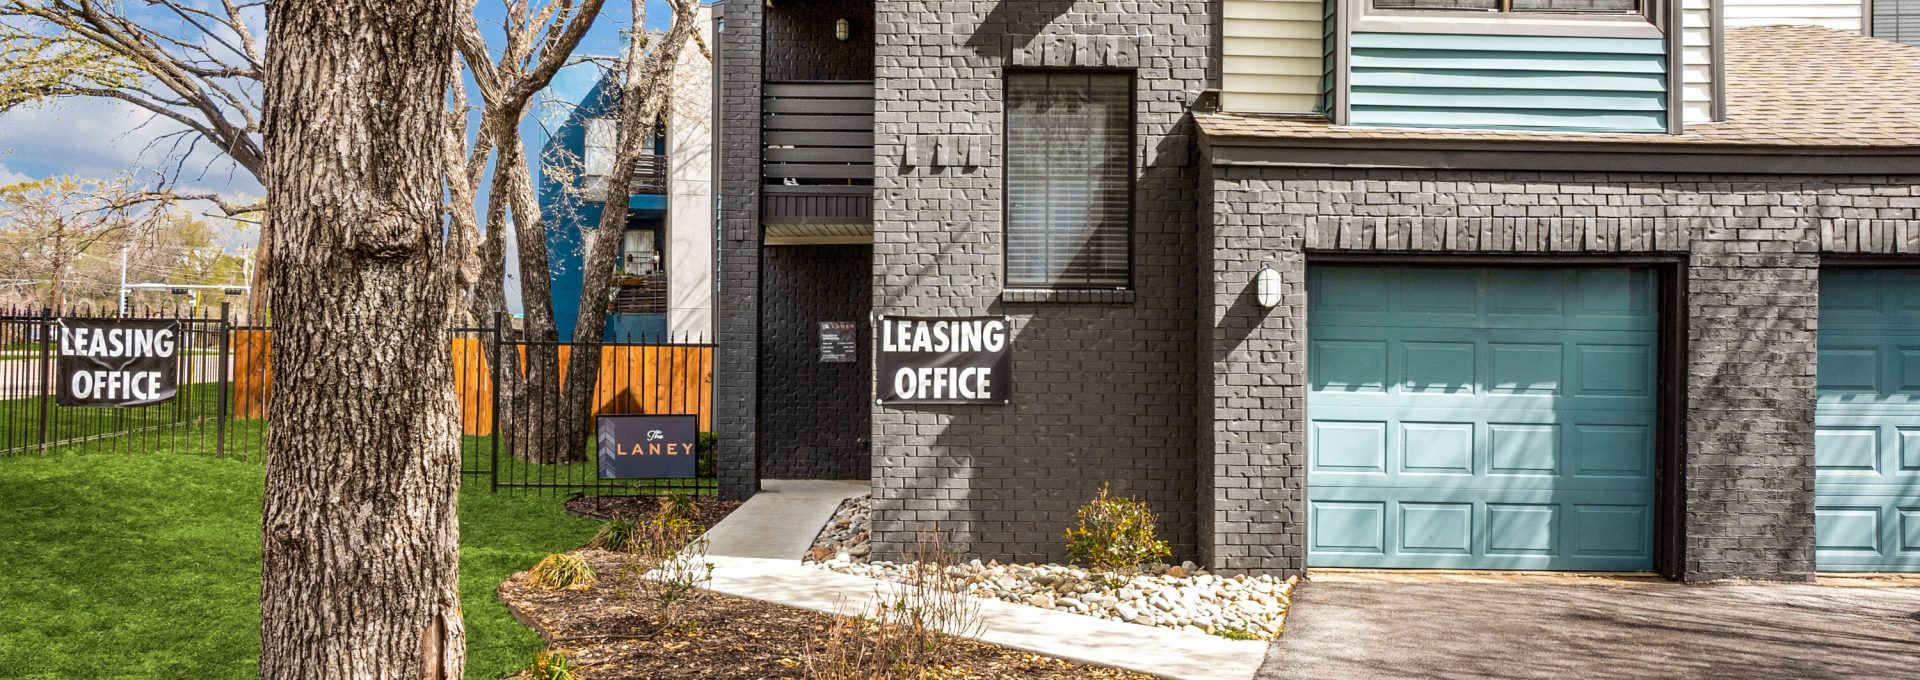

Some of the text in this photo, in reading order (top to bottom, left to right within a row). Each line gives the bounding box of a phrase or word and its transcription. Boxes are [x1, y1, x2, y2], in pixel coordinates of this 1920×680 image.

[61, 327, 174, 358] LEASING
[883, 320, 1005, 352] LEASING
[71, 370, 162, 400] OFFICE
[894, 367, 992, 400] OFFICE
[617, 443, 693, 455] LANEY
[646, 429, 664, 442] The
